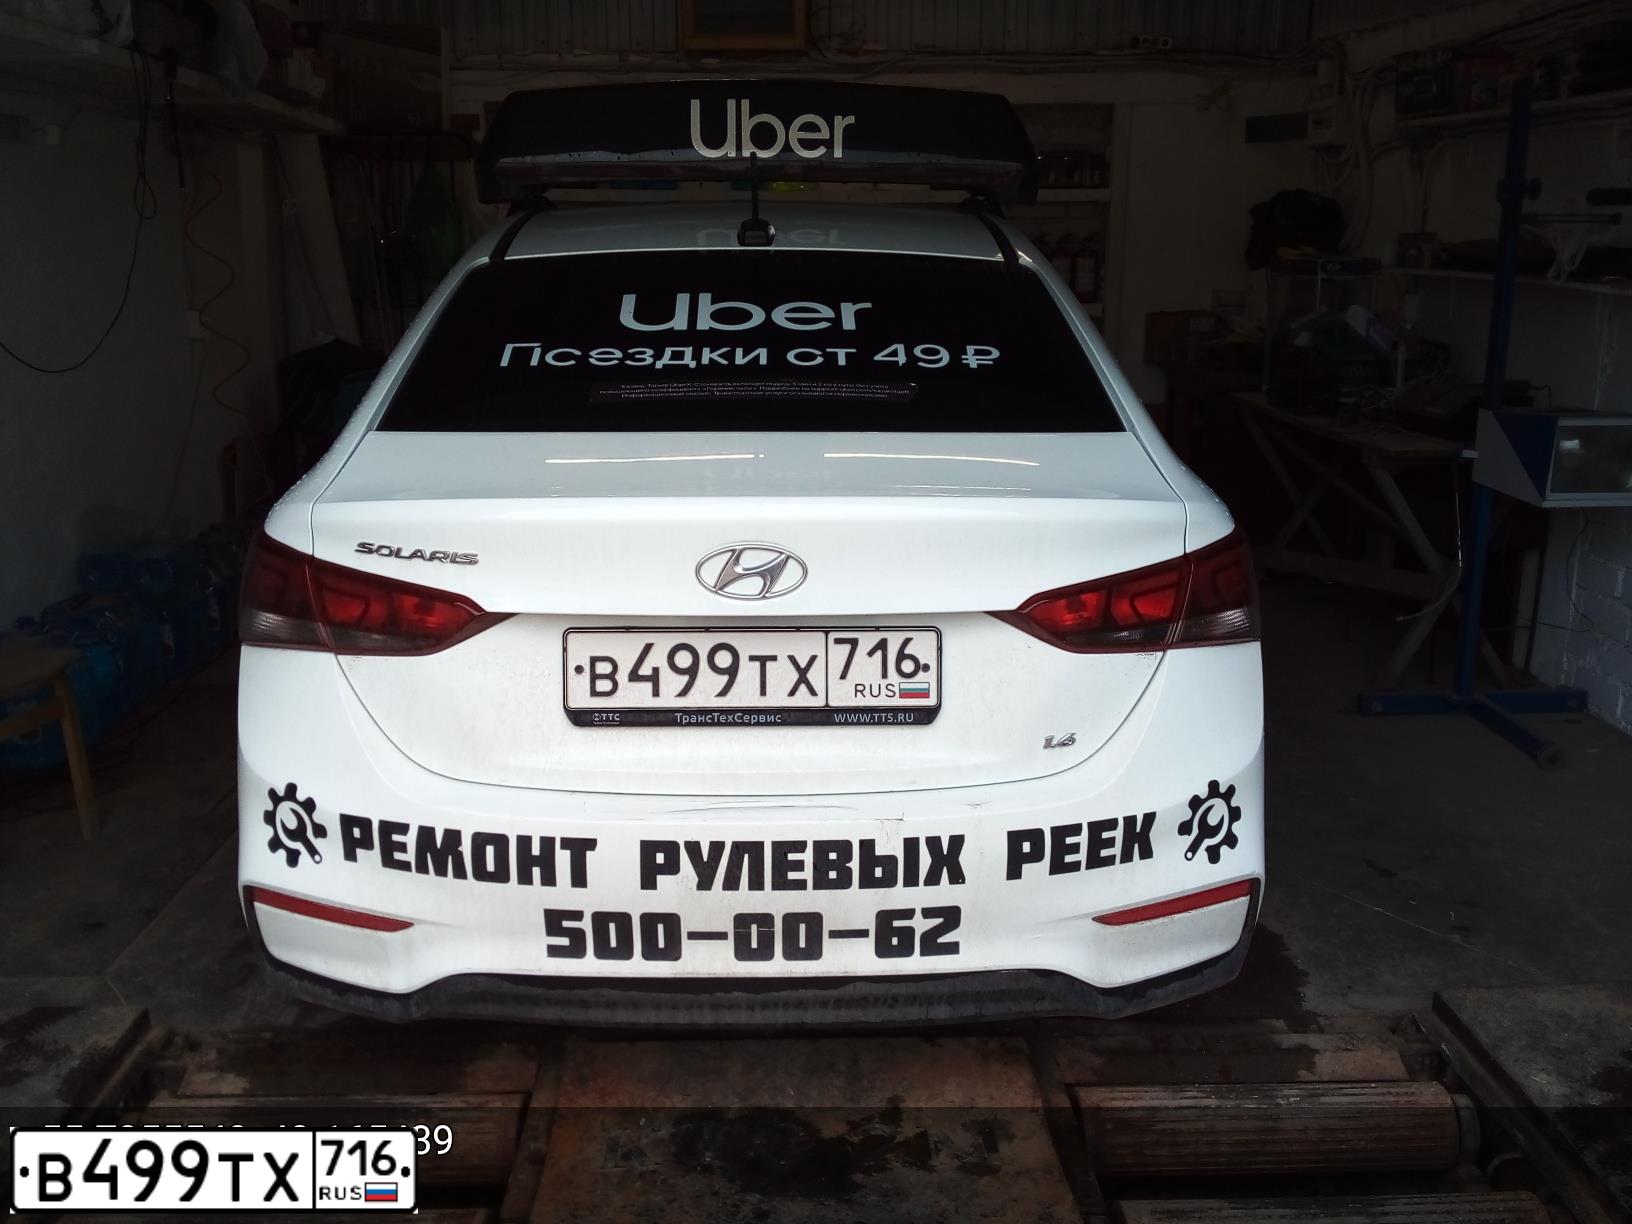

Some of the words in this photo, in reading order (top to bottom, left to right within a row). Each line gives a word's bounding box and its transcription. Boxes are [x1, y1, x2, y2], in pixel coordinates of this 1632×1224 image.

[690, 98, 856, 159] Uber
[618, 292, 873, 332] Uber
[354, 541, 480, 566] SOLARIS
[589, 641, 818, 698] В499ТХ
[833, 637, 921, 680] 716
[854, 683, 897, 698] RUS
[674, 712, 783, 725] ТрансТехСервис
[834, 712, 914, 723] WWW.TTS.RU
[339, 812, 598, 889] РЕМОНТ
[639, 833, 966, 892] РУЛЕВЫХ
[1005, 810, 1157, 881] РЕЕК
[543, 904, 962, 962] 500-00-62
